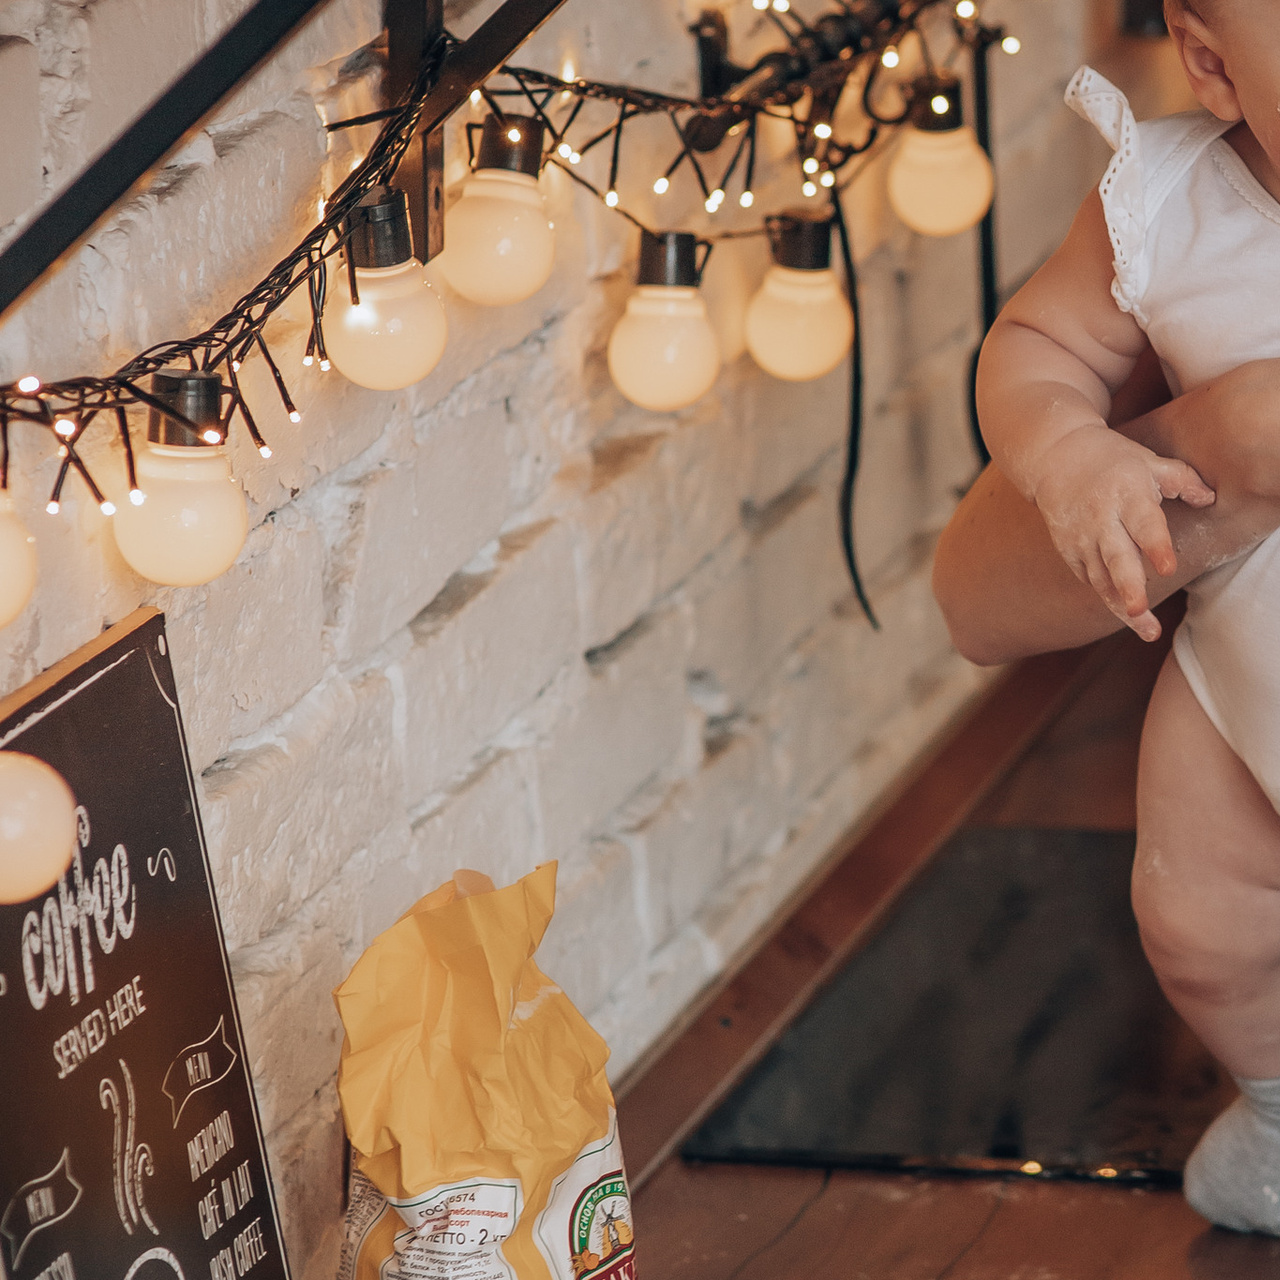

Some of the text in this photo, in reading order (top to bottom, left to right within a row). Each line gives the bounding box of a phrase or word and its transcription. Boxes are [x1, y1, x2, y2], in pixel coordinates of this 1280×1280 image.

[53, 975, 146, 1080] SERVED HERE
[419, 1198, 448, 1218] ГОСТ
[233, 1216, 267, 1278] COFFEE
[479, 1228, 488, 1246] 2
